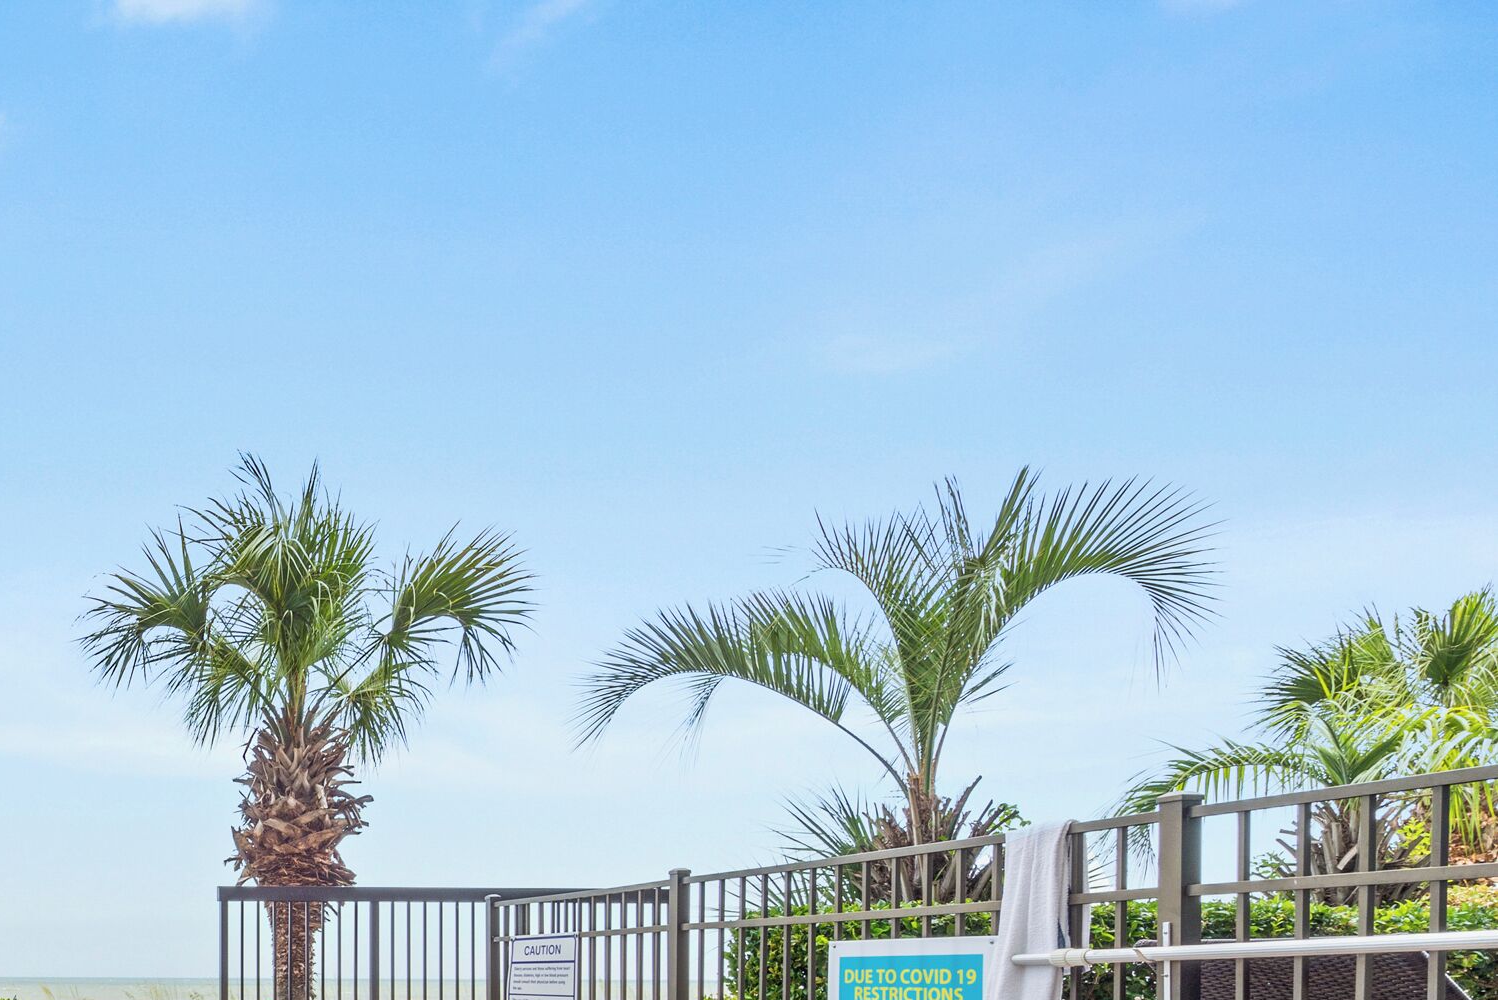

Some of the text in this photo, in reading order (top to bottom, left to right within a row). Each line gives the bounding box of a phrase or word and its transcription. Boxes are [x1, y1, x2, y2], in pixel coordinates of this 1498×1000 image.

[524, 944, 561, 956] CAUTION
[844, 968, 977, 985] DUE TO COVID 19
